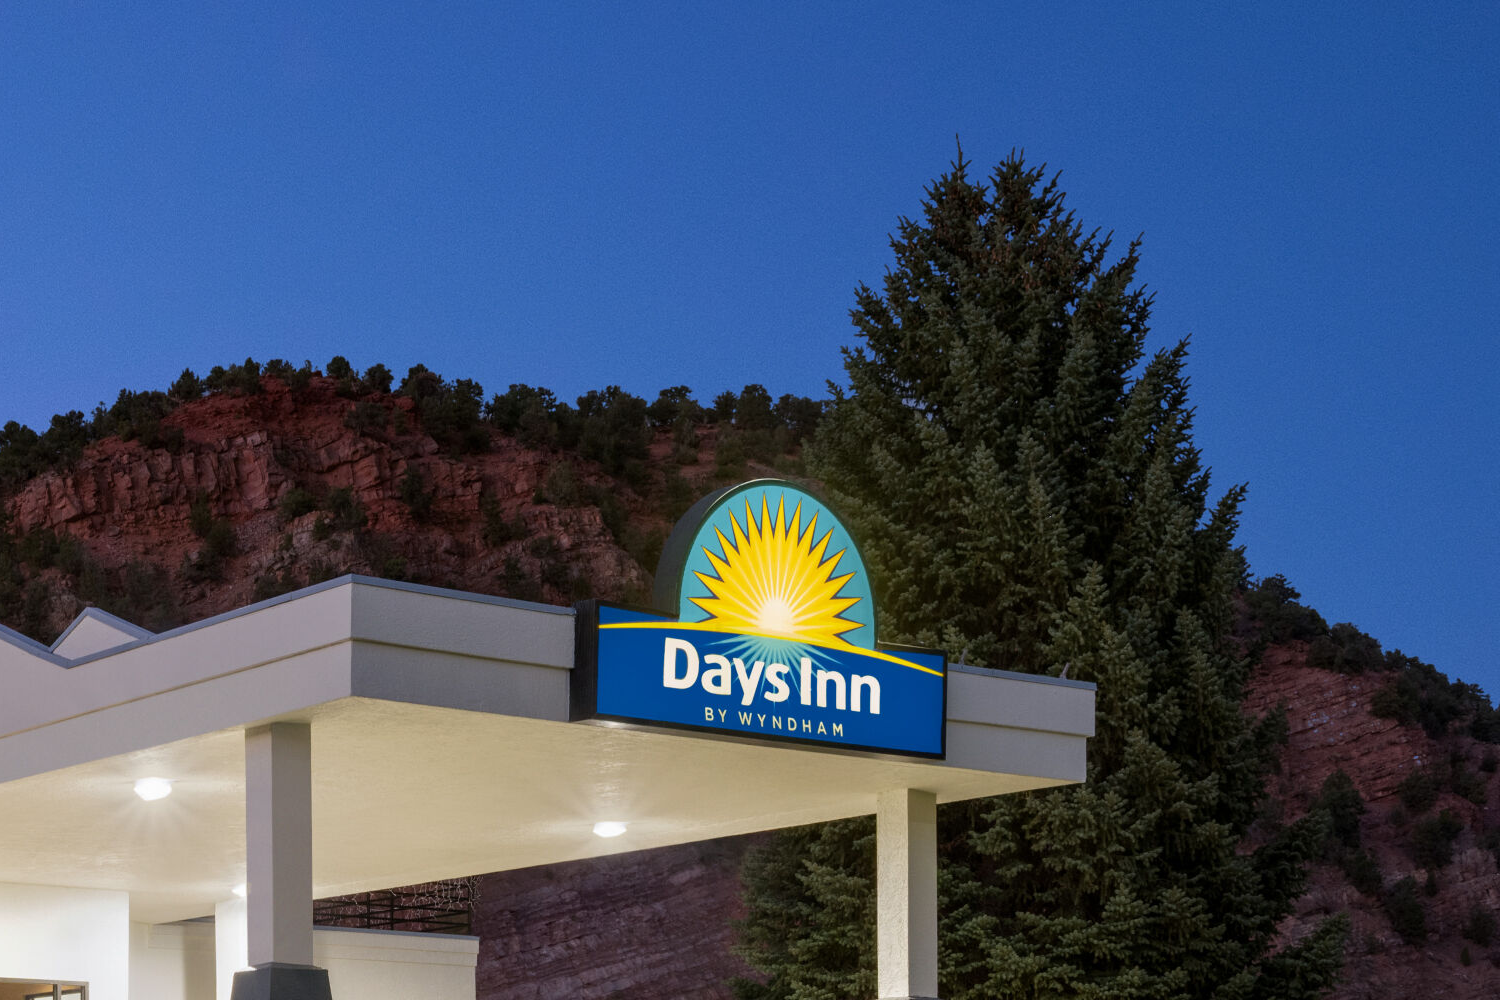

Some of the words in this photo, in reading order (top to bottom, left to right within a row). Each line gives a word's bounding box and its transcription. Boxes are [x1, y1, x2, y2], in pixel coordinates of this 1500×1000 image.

[663, 637, 790, 706] Days
[800, 656, 881, 715] Inn
[704, 707, 728, 723] BY
[738, 711, 844, 737] WYNDHAM
